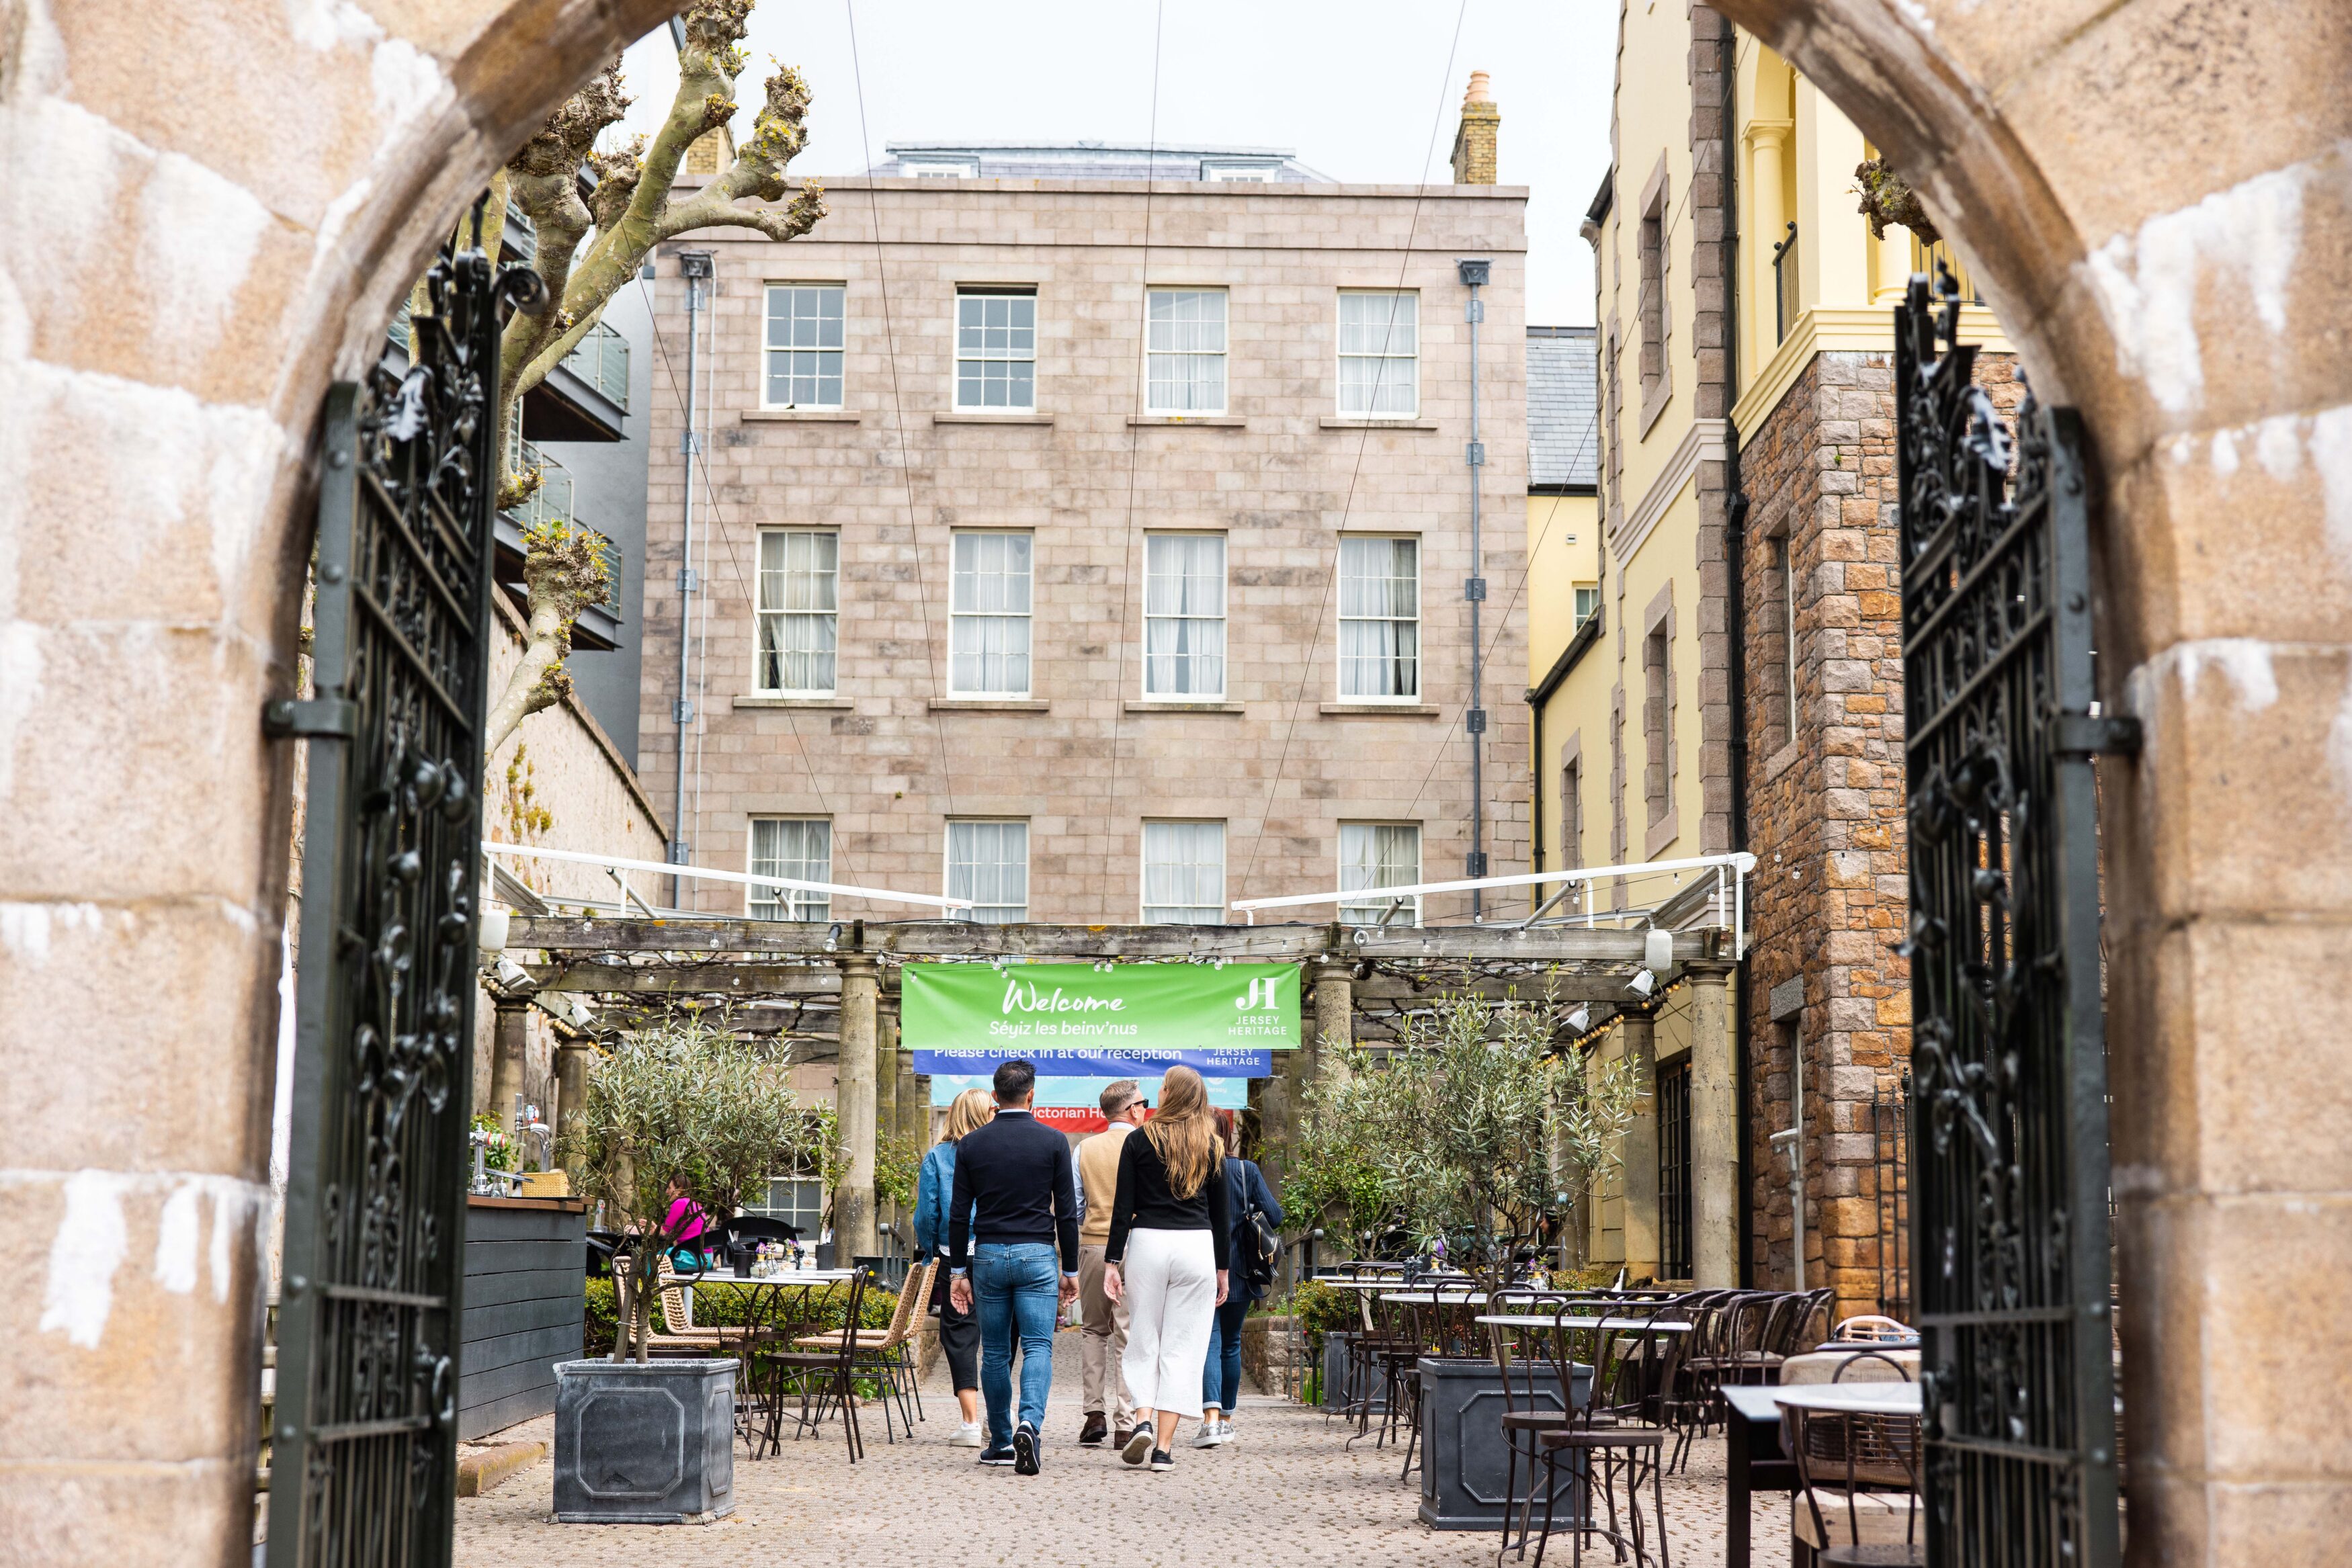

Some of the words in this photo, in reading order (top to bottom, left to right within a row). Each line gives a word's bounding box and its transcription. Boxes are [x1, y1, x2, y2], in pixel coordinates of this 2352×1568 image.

[1002, 979, 1127, 1014] Welcome
[1235, 1016, 1279, 1025] JERSEY
[989, 1020, 1032, 1039] Séyiz
[1035, 1020, 1057, 1035] les
[1228, 1027, 1288, 1035] HERITAGE
[934, 1049, 984, 1057] Please
[989, 1049, 1036, 1058] check
[1040, 1049, 1054, 1059] in
[1057, 1049, 1074, 1059] at
[1077, 1049, 1103, 1059] our
[1107, 1049, 1182, 1063] reception
[1206, 1057, 1260, 1065] HERITAGE
[1032, 1107, 1085, 1118] ictorian
